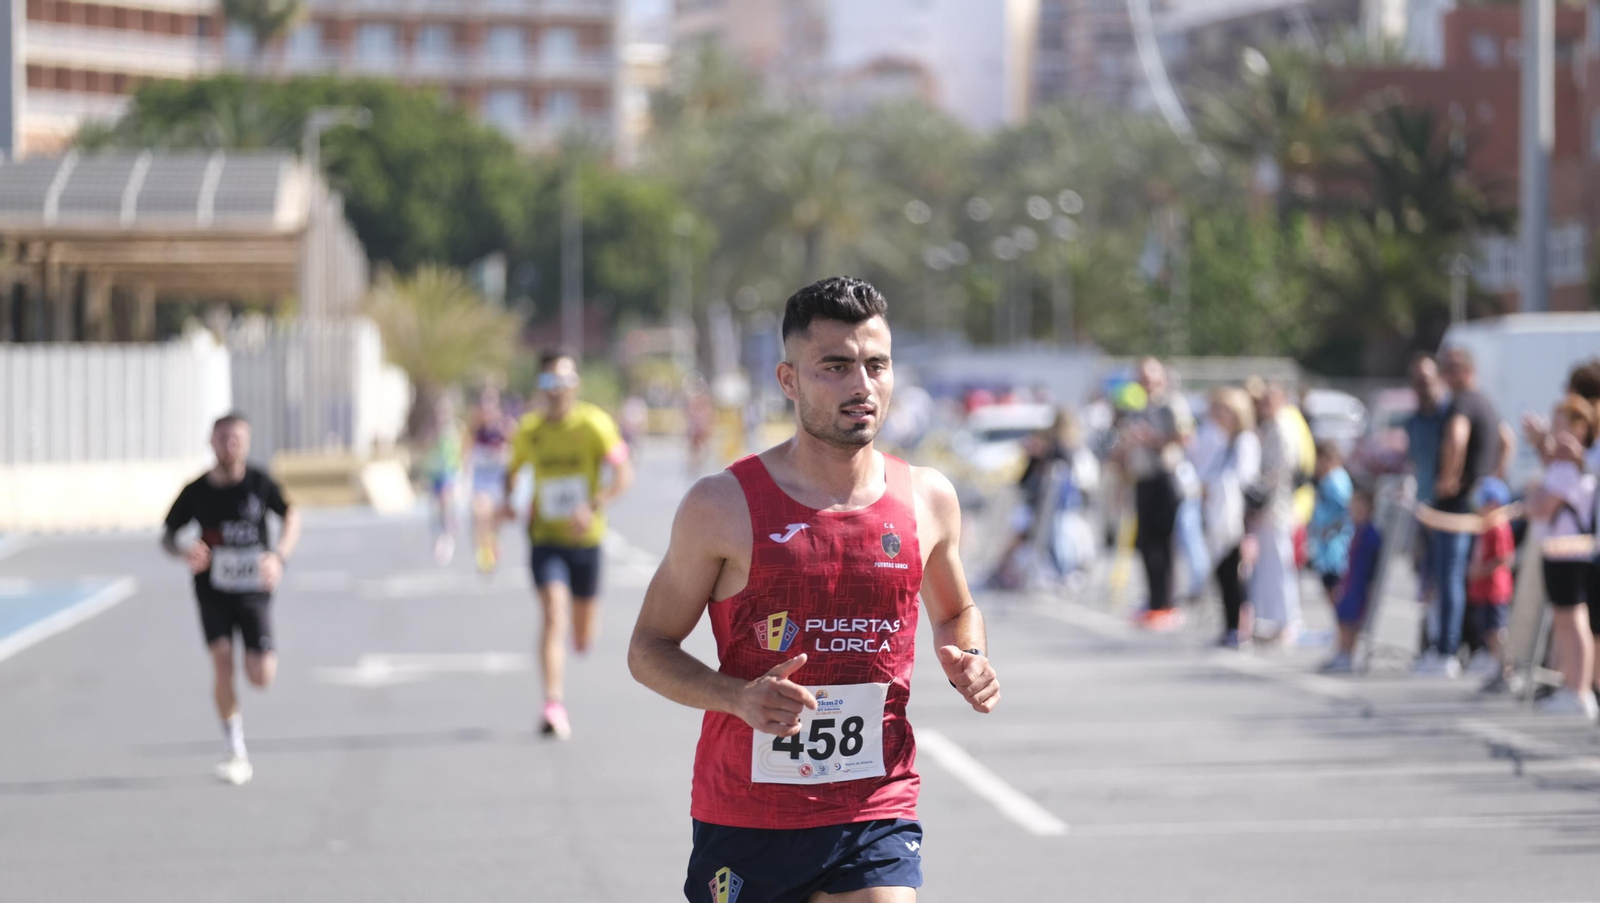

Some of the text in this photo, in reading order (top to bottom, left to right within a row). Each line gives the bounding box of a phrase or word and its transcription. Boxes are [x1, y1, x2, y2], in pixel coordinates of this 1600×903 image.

[805, 618, 901, 634] PUERTAS
[815, 638, 891, 653] LORCA
[772, 715, 864, 761] 458
